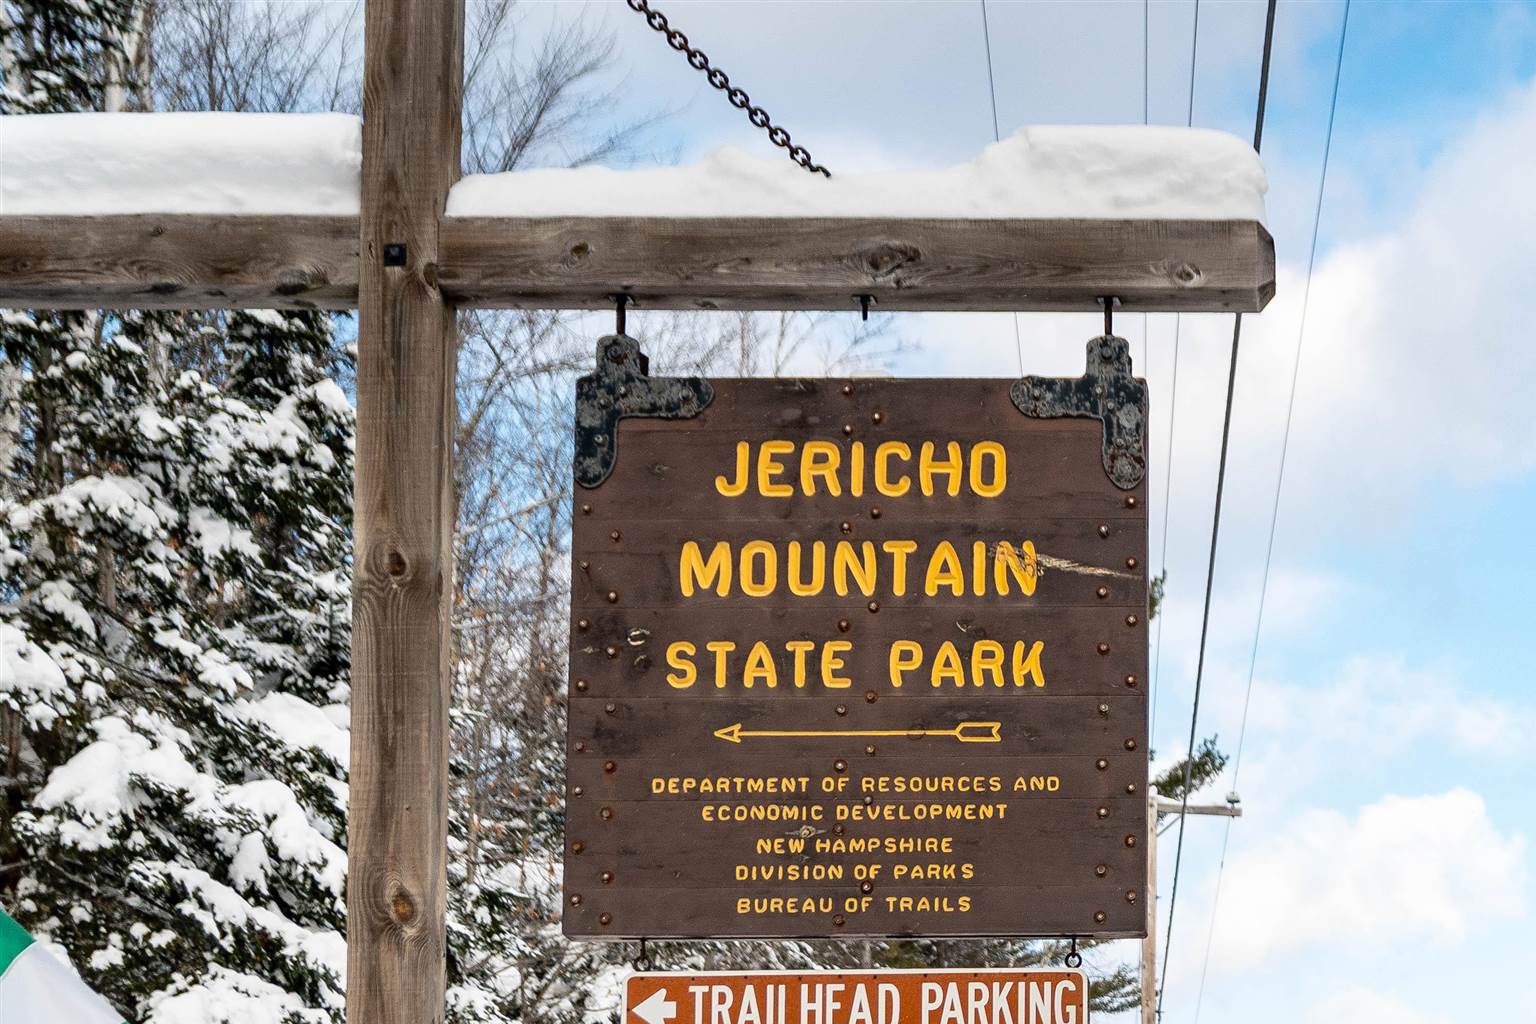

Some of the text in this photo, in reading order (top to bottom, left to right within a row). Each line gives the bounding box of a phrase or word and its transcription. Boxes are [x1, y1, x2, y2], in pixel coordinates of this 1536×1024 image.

[714, 439, 1007, 499] JERICHO
[679, 539, 1039, 598] MOUNTAIN
[665, 639, 1046, 689] STATE PARK
[651, 775, 1060, 794] DEPARTMENT OF RESOURCES AND
[701, 803, 1008, 822] ECONOMIC DEVELOPMENT
[756, 837, 953, 855] NEW HAMPSHIRE
[735, 863, 975, 881] DIVISION OF PARKS
[736, 895, 972, 914] BUREAU OF TRAILS
